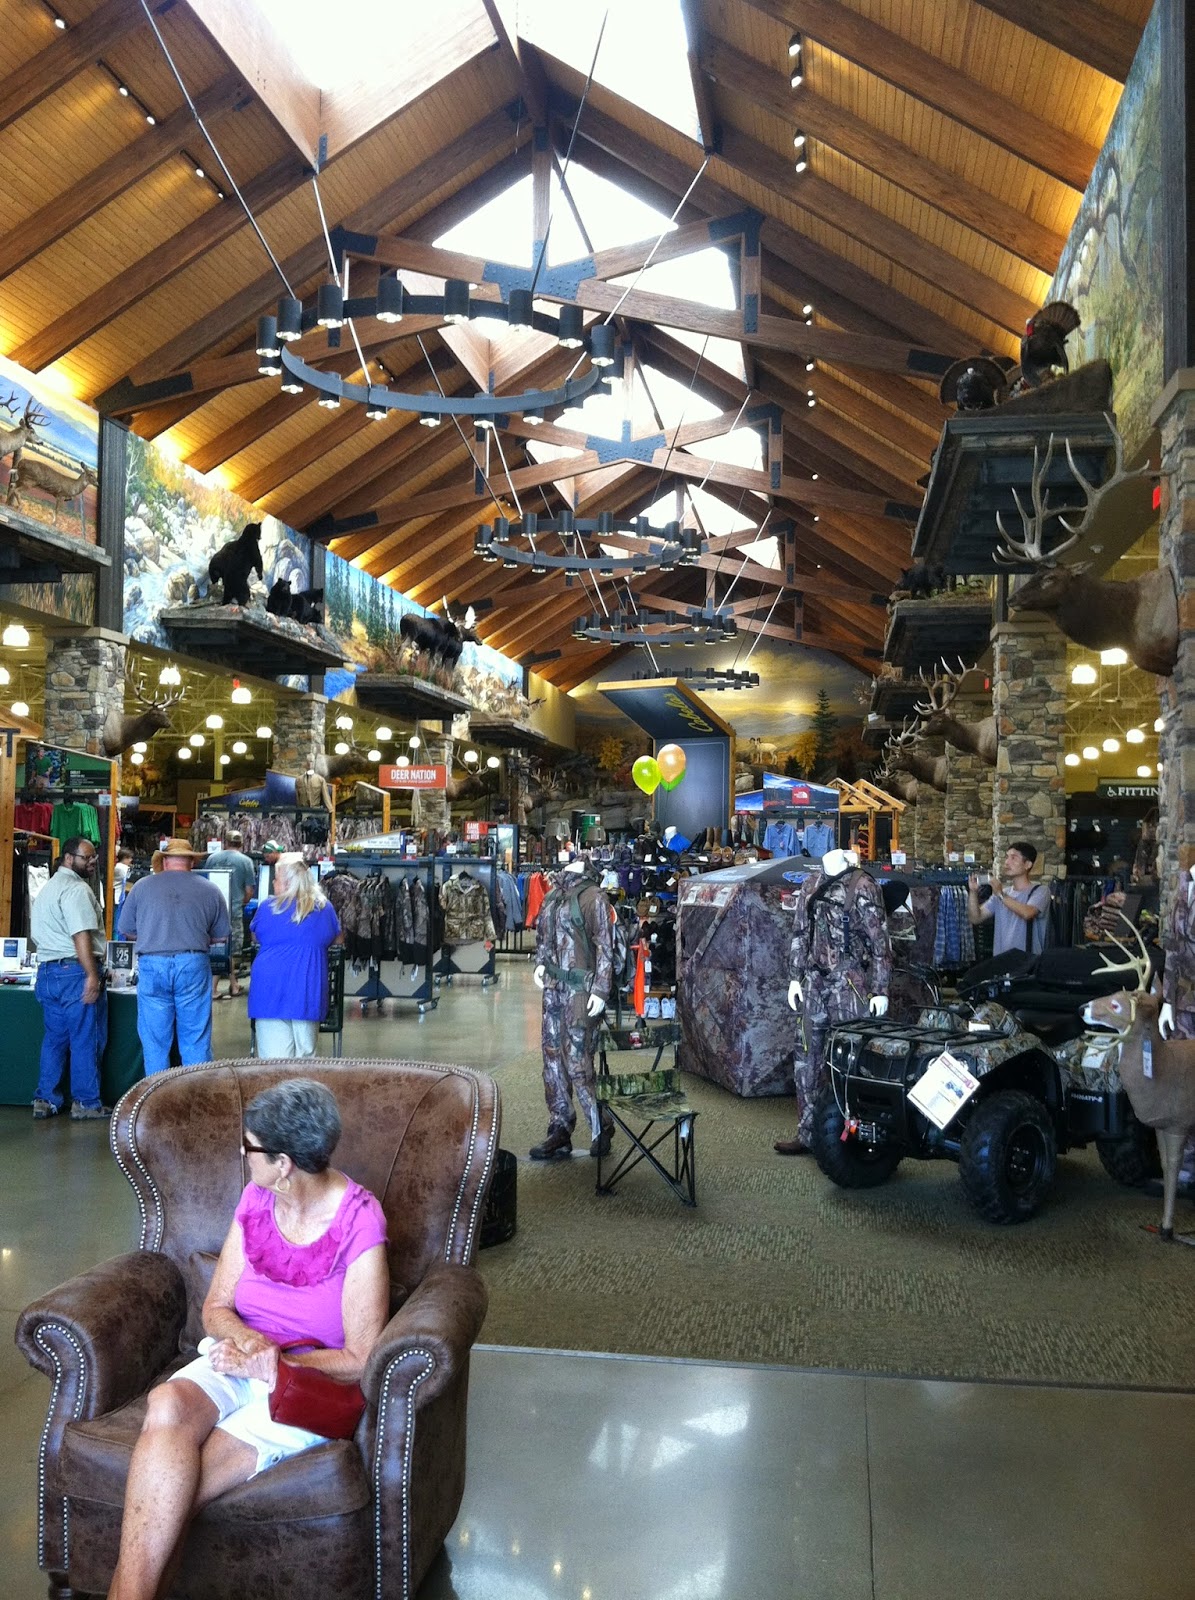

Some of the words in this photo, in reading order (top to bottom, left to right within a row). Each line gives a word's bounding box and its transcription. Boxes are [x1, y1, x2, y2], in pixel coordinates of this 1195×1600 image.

[390, 769, 409, 780] DEER
[410, 769, 437, 781] NATION
[115, 949, 129, 962] $25
